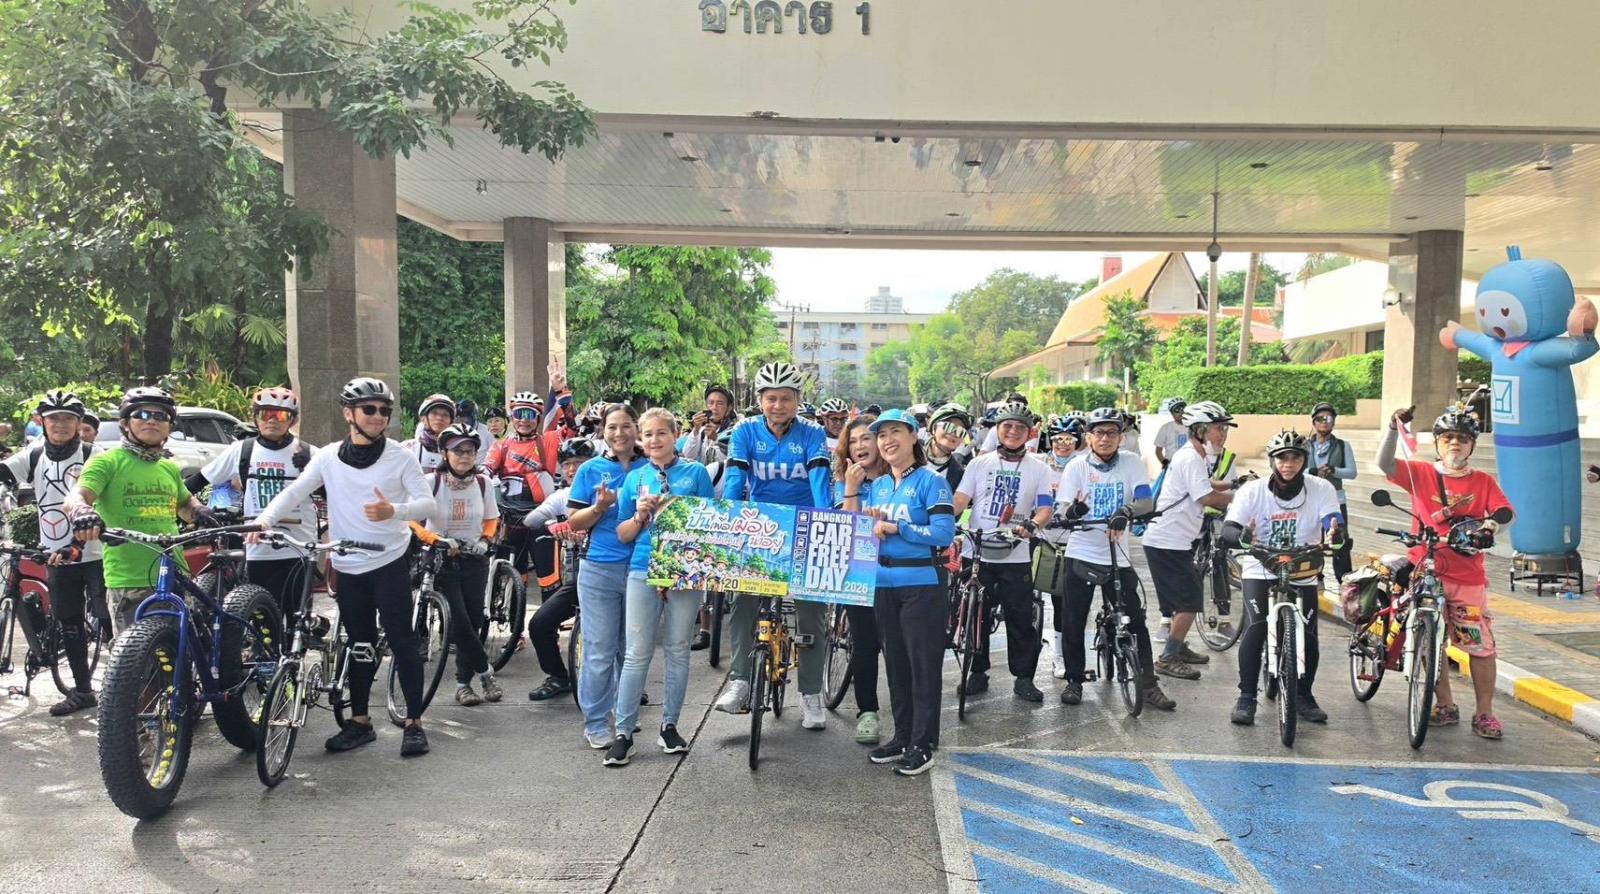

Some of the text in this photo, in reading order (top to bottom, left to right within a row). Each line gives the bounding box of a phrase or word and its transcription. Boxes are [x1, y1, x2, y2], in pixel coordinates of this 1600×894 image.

[698, 0, 871, 35] อาคาร 1
[751, 458, 809, 481] NHA
[1094, 487, 1115, 500] CAR
[812, 511, 853, 525] BANGKOK
[809, 521, 853, 547] CAR
[806, 542, 851, 569] FREE
[723, 577, 740, 590] 20
[804, 565, 849, 592] DAY
[843, 580, 869, 595] 2026
